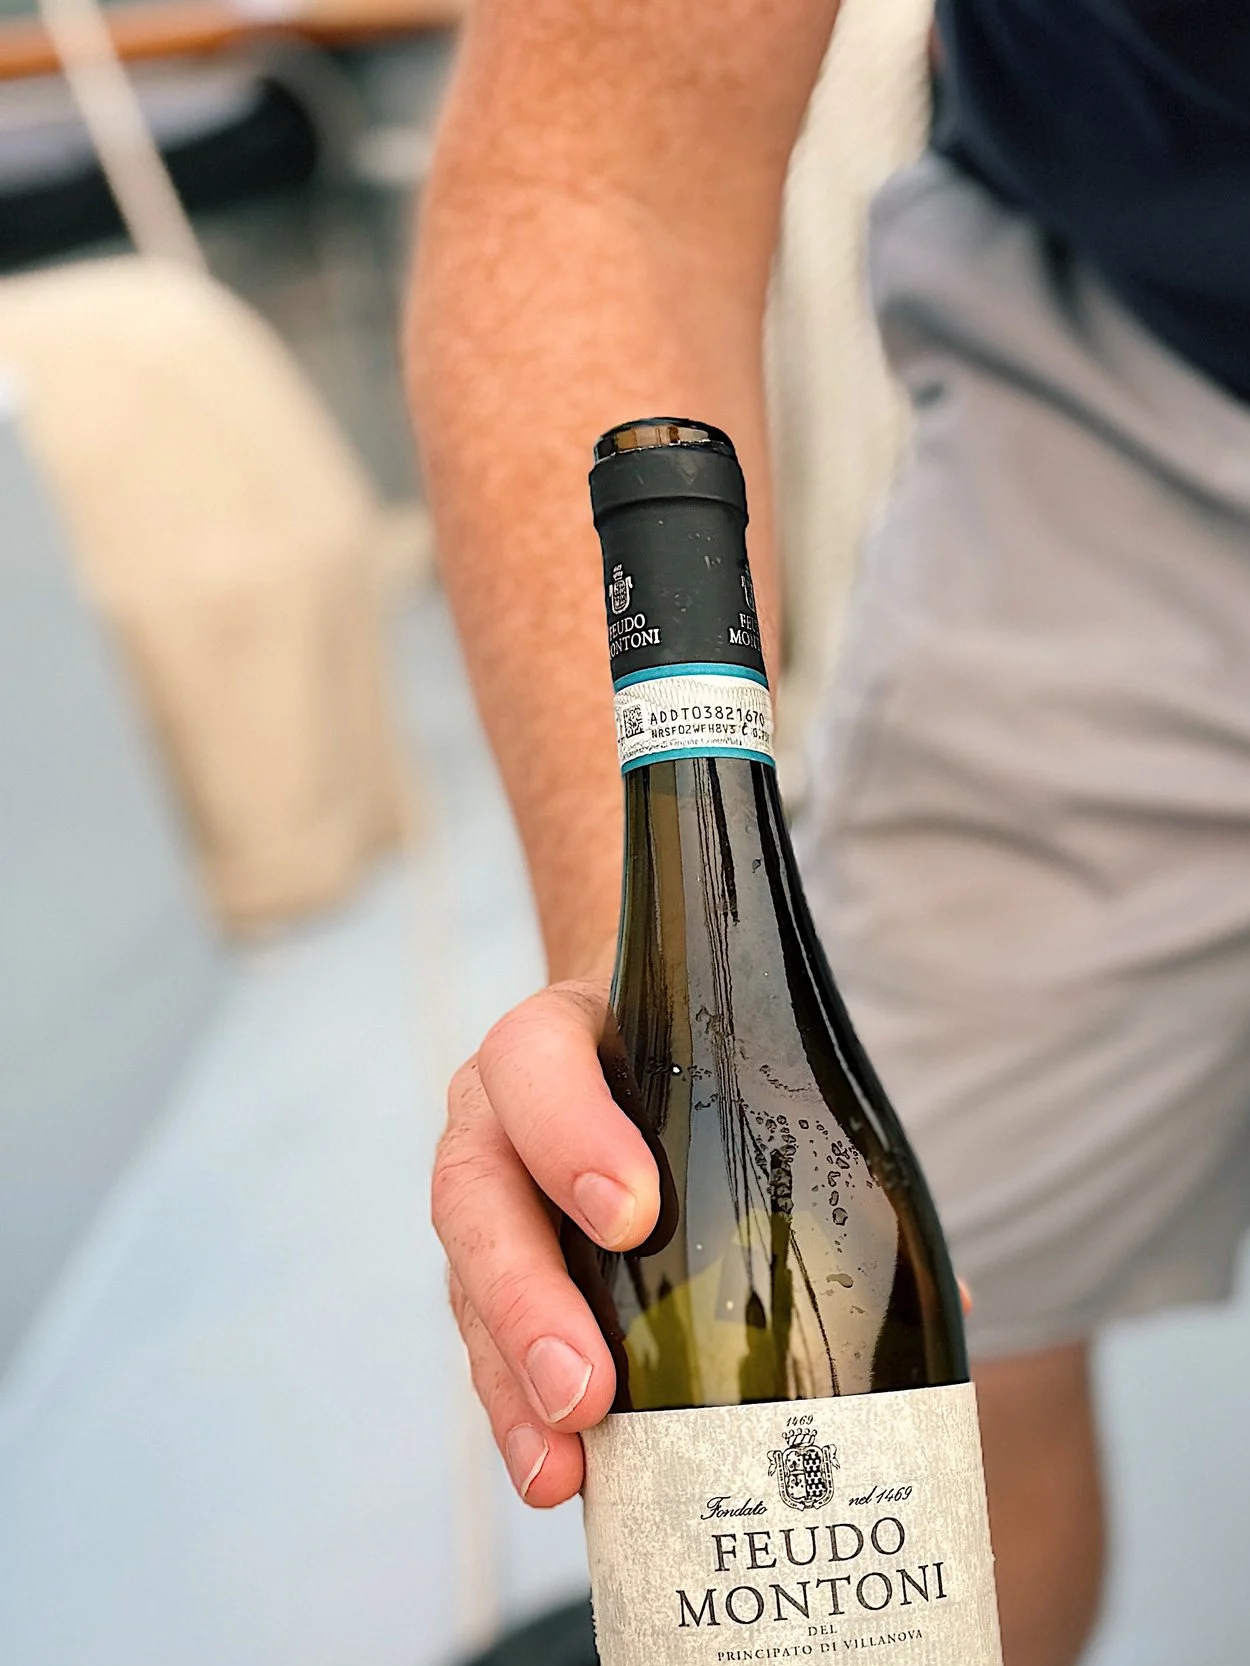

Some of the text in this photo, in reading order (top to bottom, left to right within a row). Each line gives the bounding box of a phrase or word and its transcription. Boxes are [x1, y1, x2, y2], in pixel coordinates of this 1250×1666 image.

[609, 613, 646, 642] FEUDO
[739, 613, 760, 636] FEU
[610, 628, 661, 660] ONTONI
[786, 1415, 814, 1427] 1469
[700, 1485, 913, 1520] Fondato nel 1469
[711, 1516, 906, 1572] FEUDO
[675, 1562, 948, 1628] MONTONI
[717, 1629, 923, 1662] PRINCIPATO DI VILLANOVA
[807, 1624, 838, 1637] DEL
